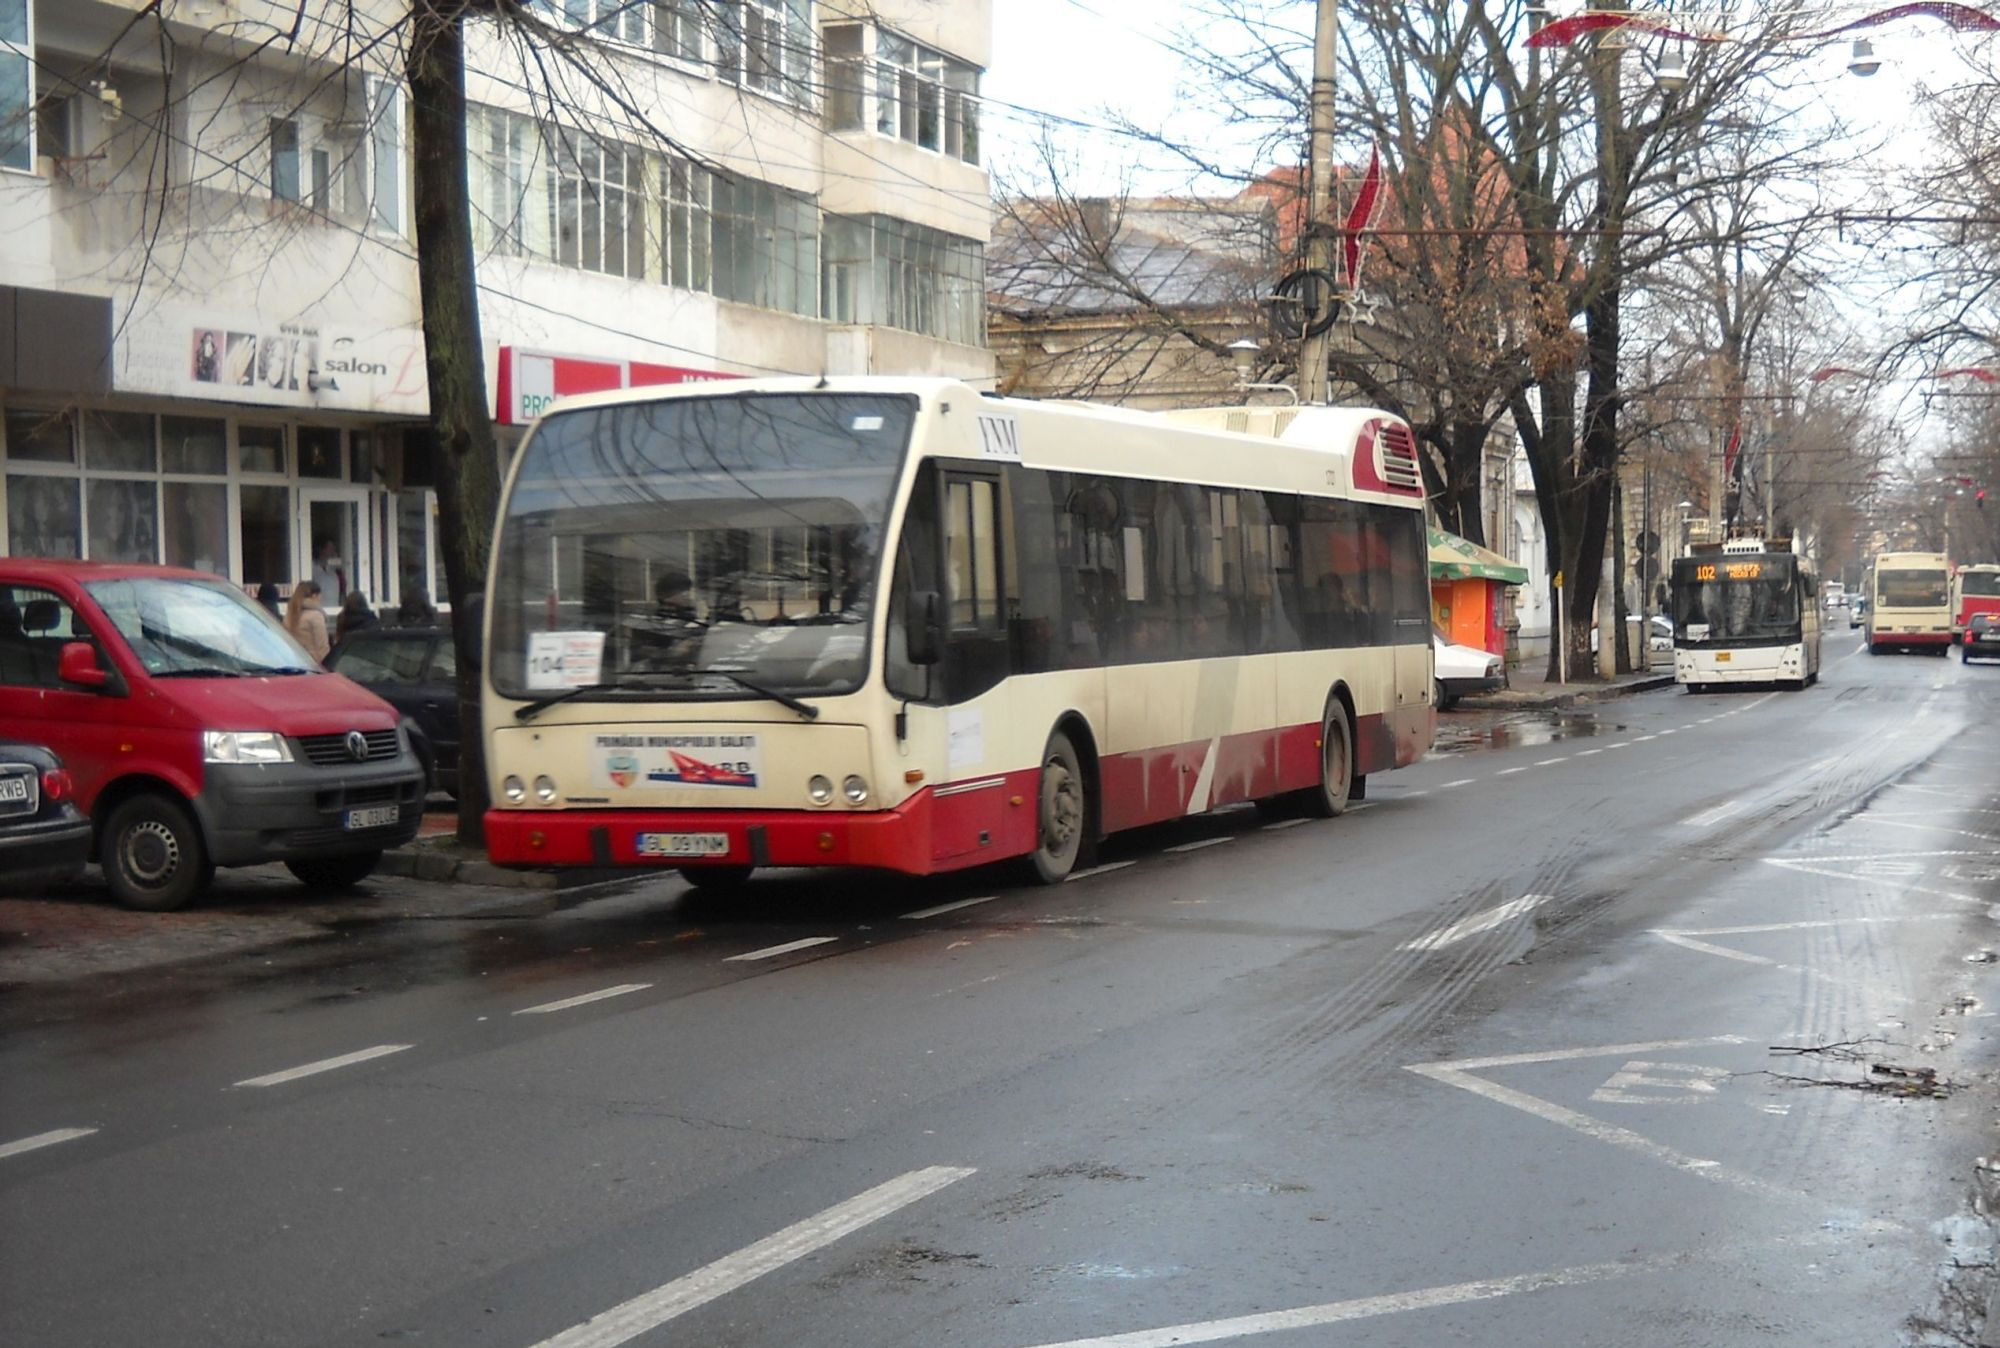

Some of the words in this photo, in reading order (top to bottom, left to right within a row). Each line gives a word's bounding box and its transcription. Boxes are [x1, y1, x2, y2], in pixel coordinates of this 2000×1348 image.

[325, 357, 387, 375] salon
[978, 415, 1018, 455] YNM
[1697, 565, 1716, 580] 102
[531, 656, 563, 674] 104
[646, 835, 667, 851] GL
[671, 836, 690, 851] 09
